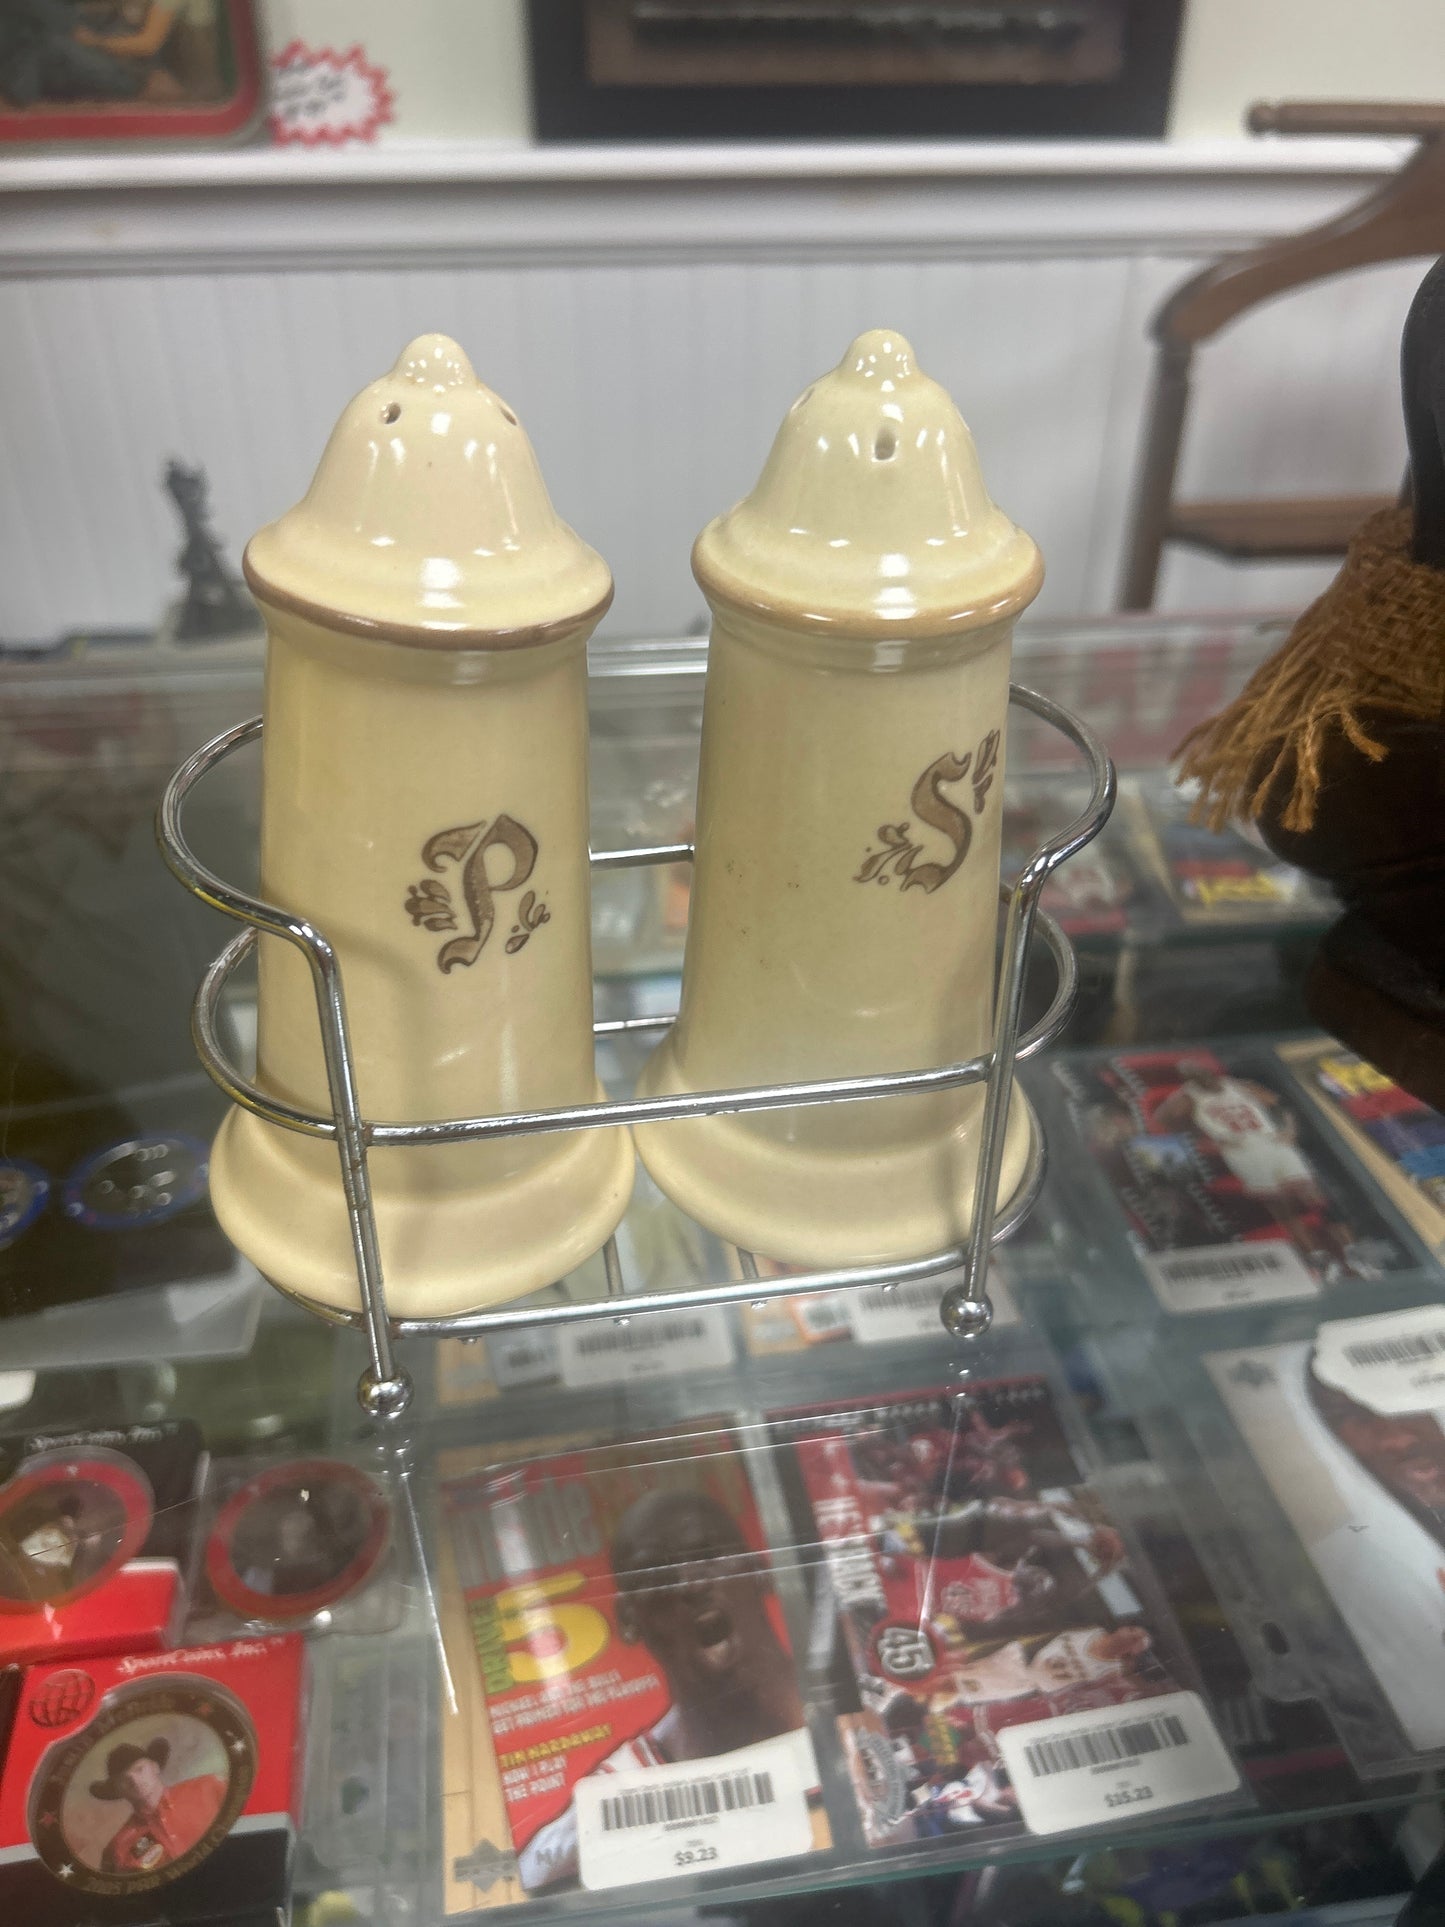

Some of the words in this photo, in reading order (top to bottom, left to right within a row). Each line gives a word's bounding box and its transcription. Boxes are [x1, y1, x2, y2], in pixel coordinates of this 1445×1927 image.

[420, 813, 541, 975] P
[876, 1626, 936, 1687] 45
[527, 1722, 613, 1760] HARDAWAY
[674, 1846, 718, 1867] $9.23
